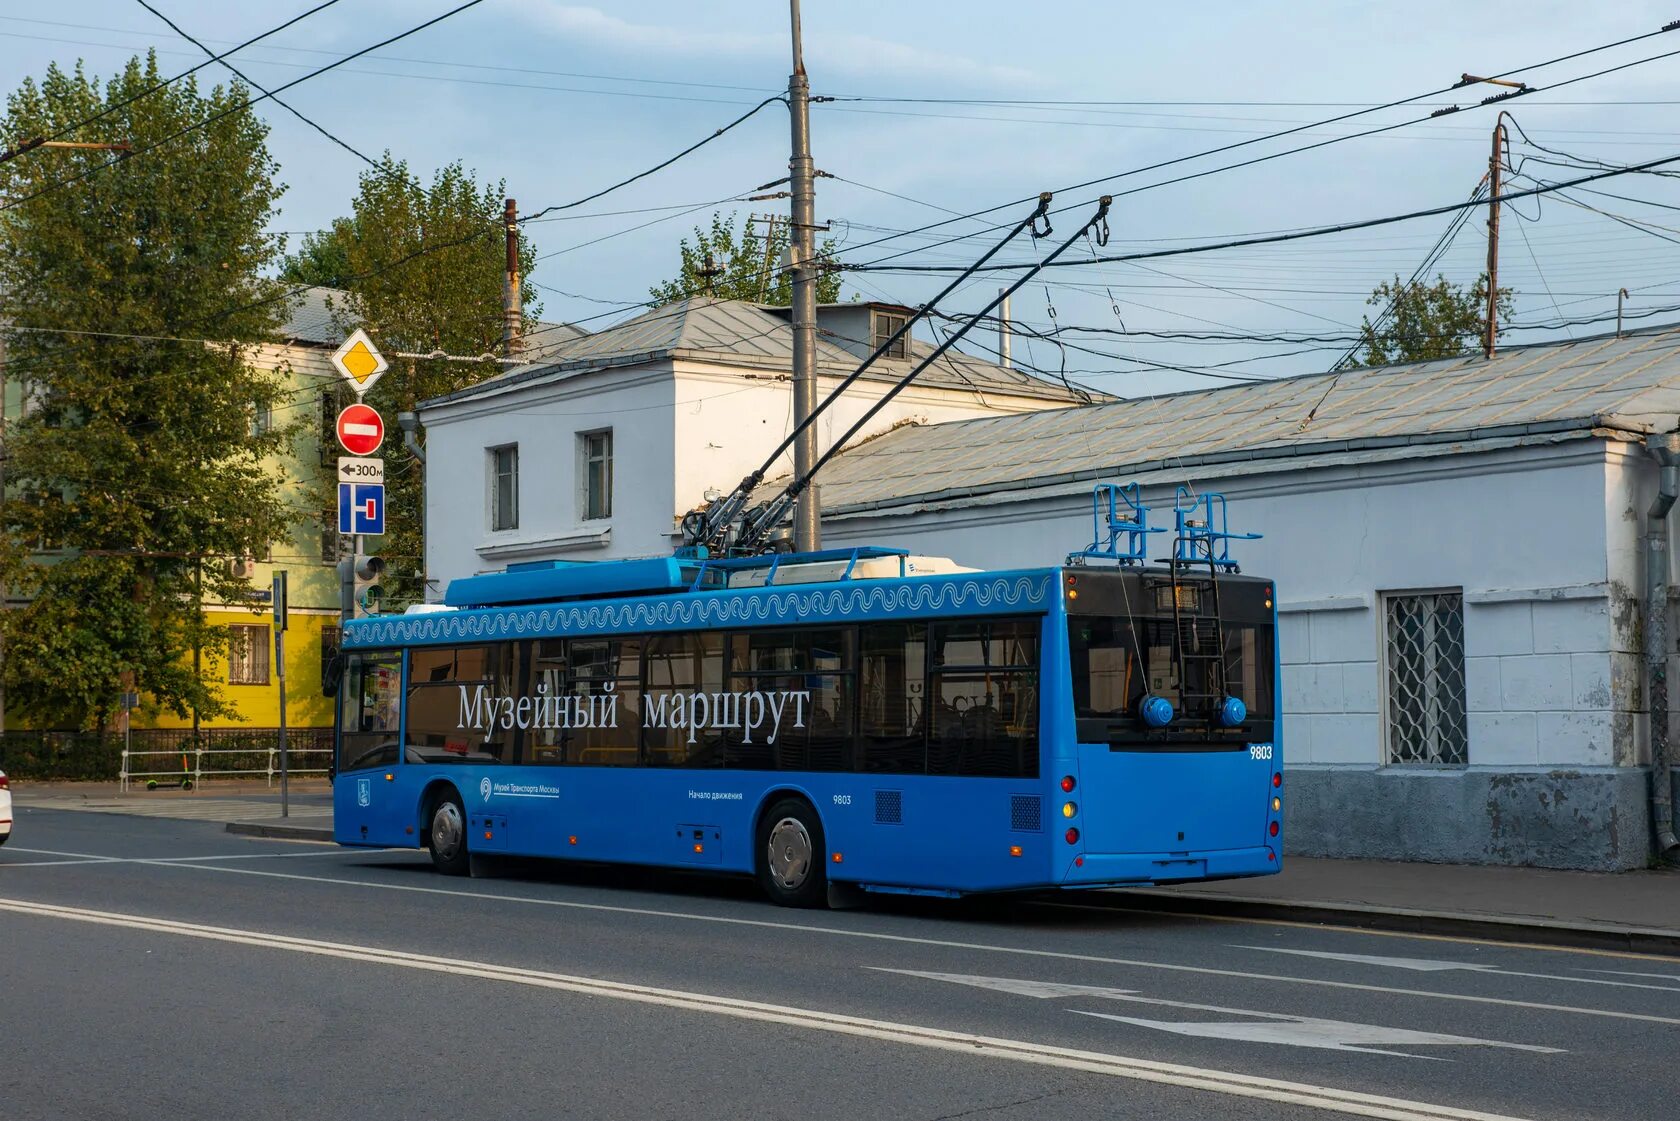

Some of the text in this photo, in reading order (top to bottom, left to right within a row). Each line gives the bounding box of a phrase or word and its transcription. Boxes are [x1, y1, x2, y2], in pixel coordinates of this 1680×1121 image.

[456, 682, 618, 743] Музейный
[642, 690, 810, 744] маршрут
[1250, 746, 1272, 760] 9803
[494, 783, 560, 794] Музей Транспорта Москвы
[688, 790, 743, 800] Начало движения
[832, 795, 852, 805] 9803
